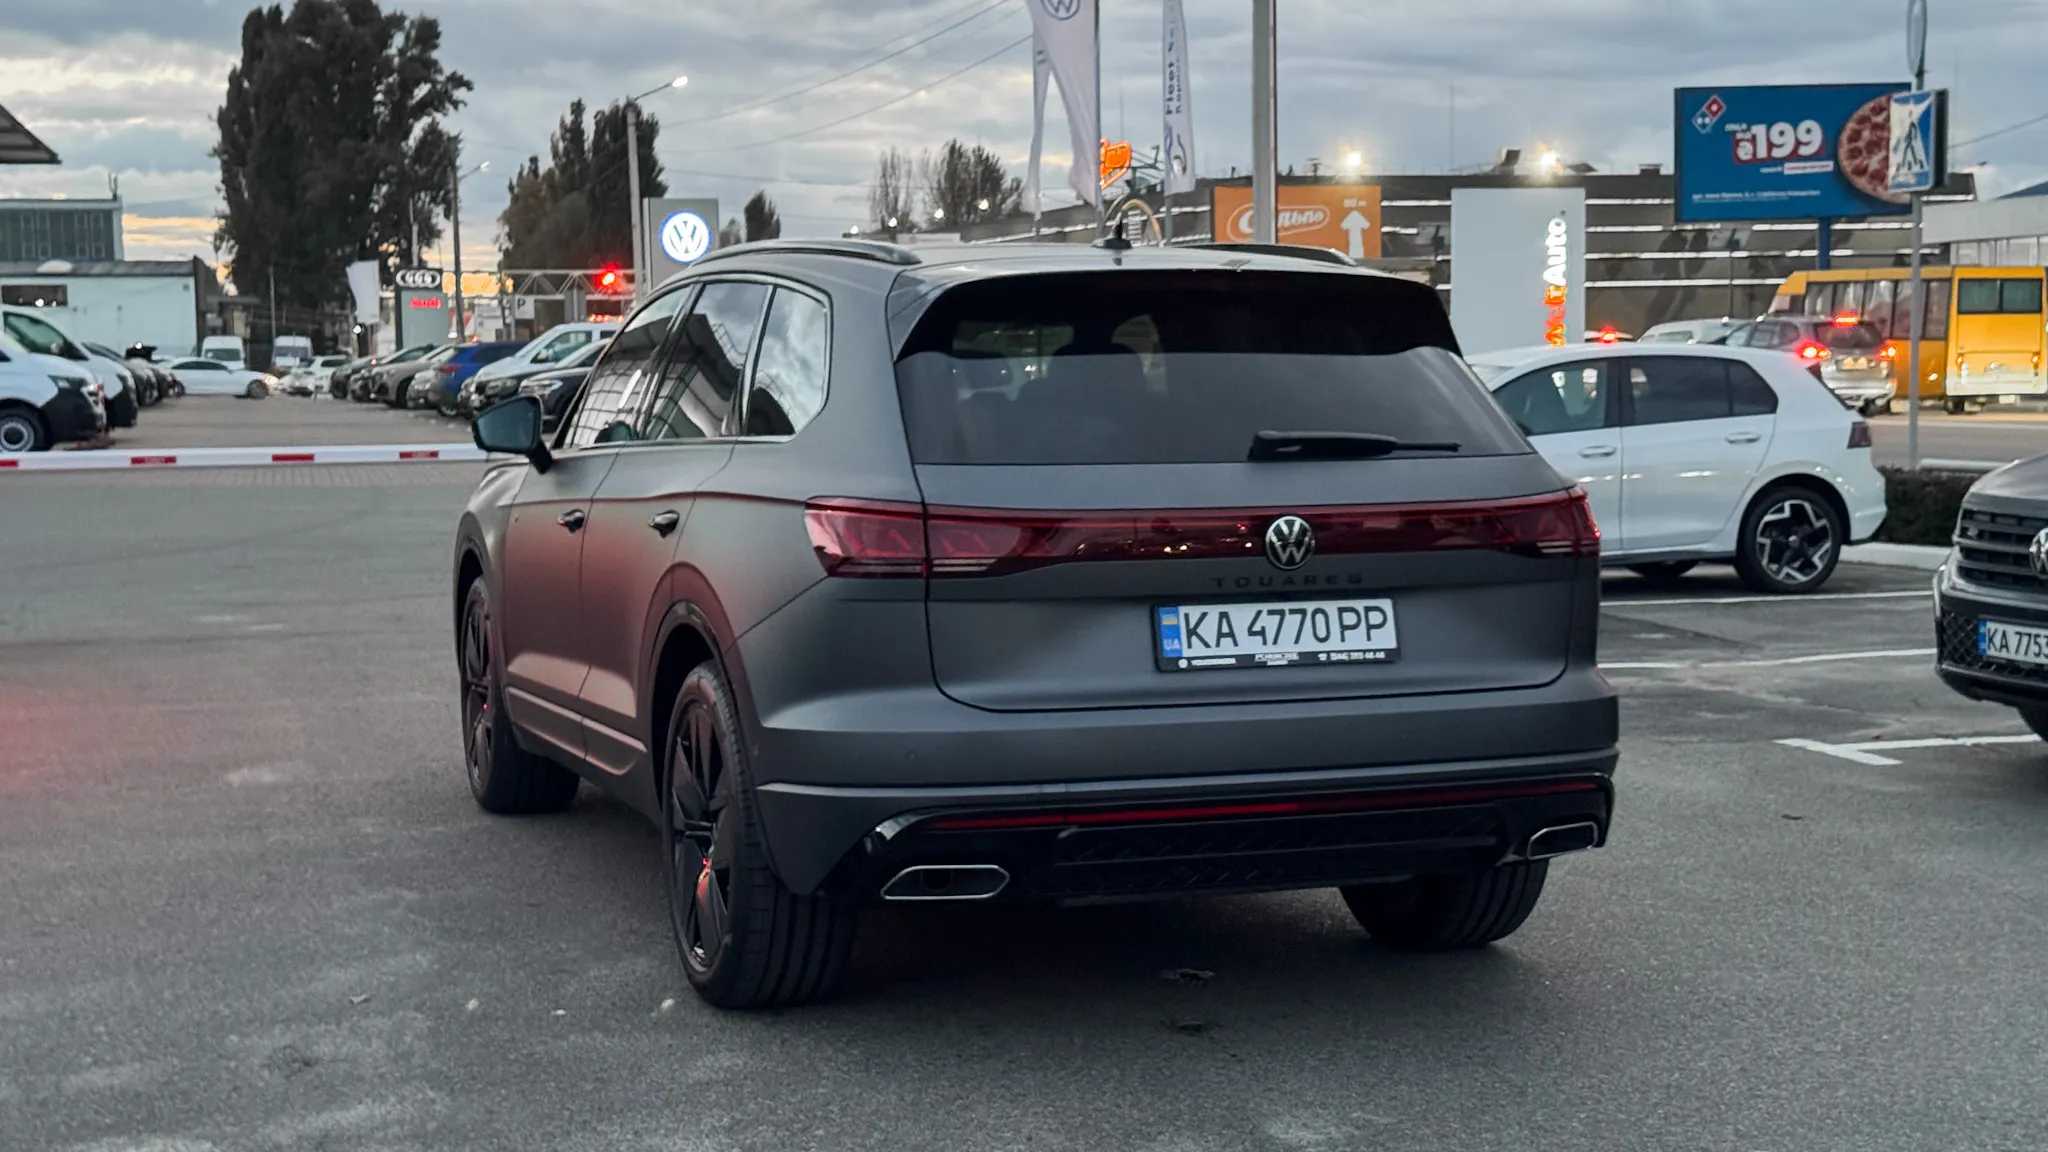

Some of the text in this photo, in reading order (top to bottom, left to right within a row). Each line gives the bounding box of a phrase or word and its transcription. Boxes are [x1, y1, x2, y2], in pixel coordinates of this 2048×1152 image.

[1212, 573, 1363, 589] TOUAREG
[1183, 605, 1389, 650] KA 4770 PP
[1987, 627, 2010, 654] KA
